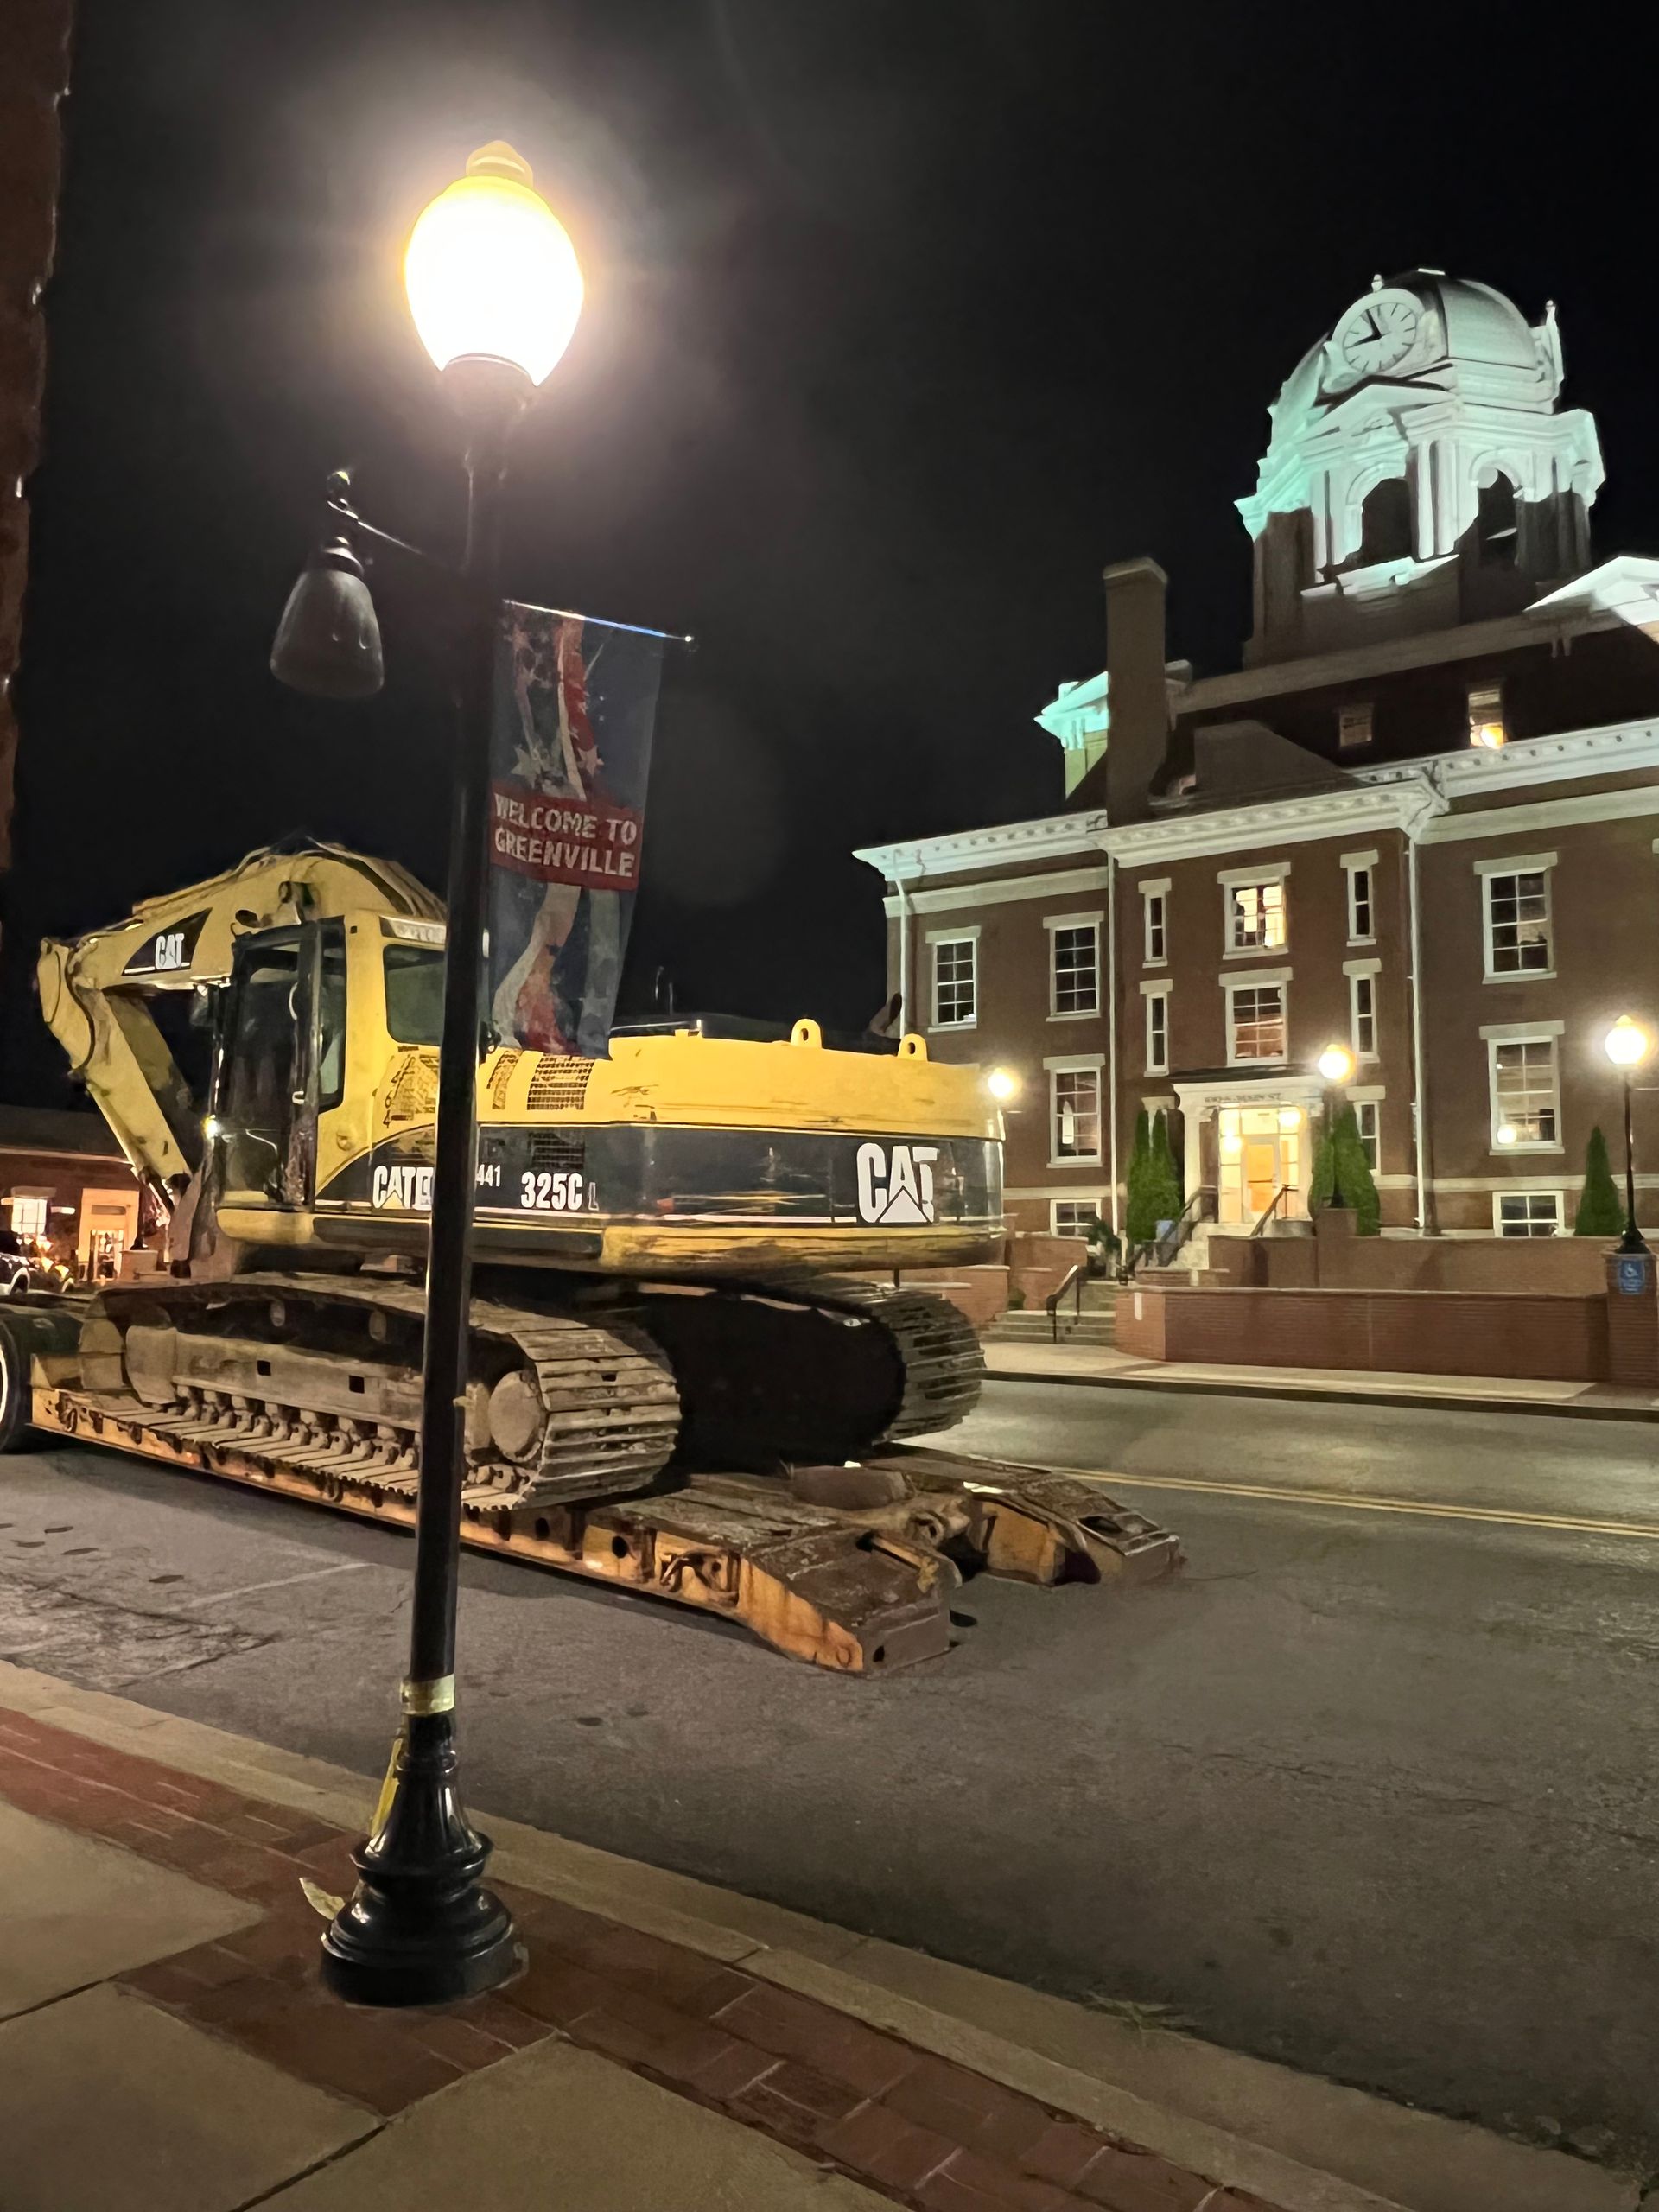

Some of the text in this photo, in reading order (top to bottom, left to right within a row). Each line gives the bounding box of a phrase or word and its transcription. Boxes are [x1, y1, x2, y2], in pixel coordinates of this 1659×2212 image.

[494, 793, 637, 845] WELCOME TO
[495, 826, 635, 878] GREENVILLE
[156, 933, 185, 969] CAT
[372, 1165, 434, 1211] CATE
[520, 1171, 583, 1211] 325C
[856, 1142, 939, 1223] CAT
